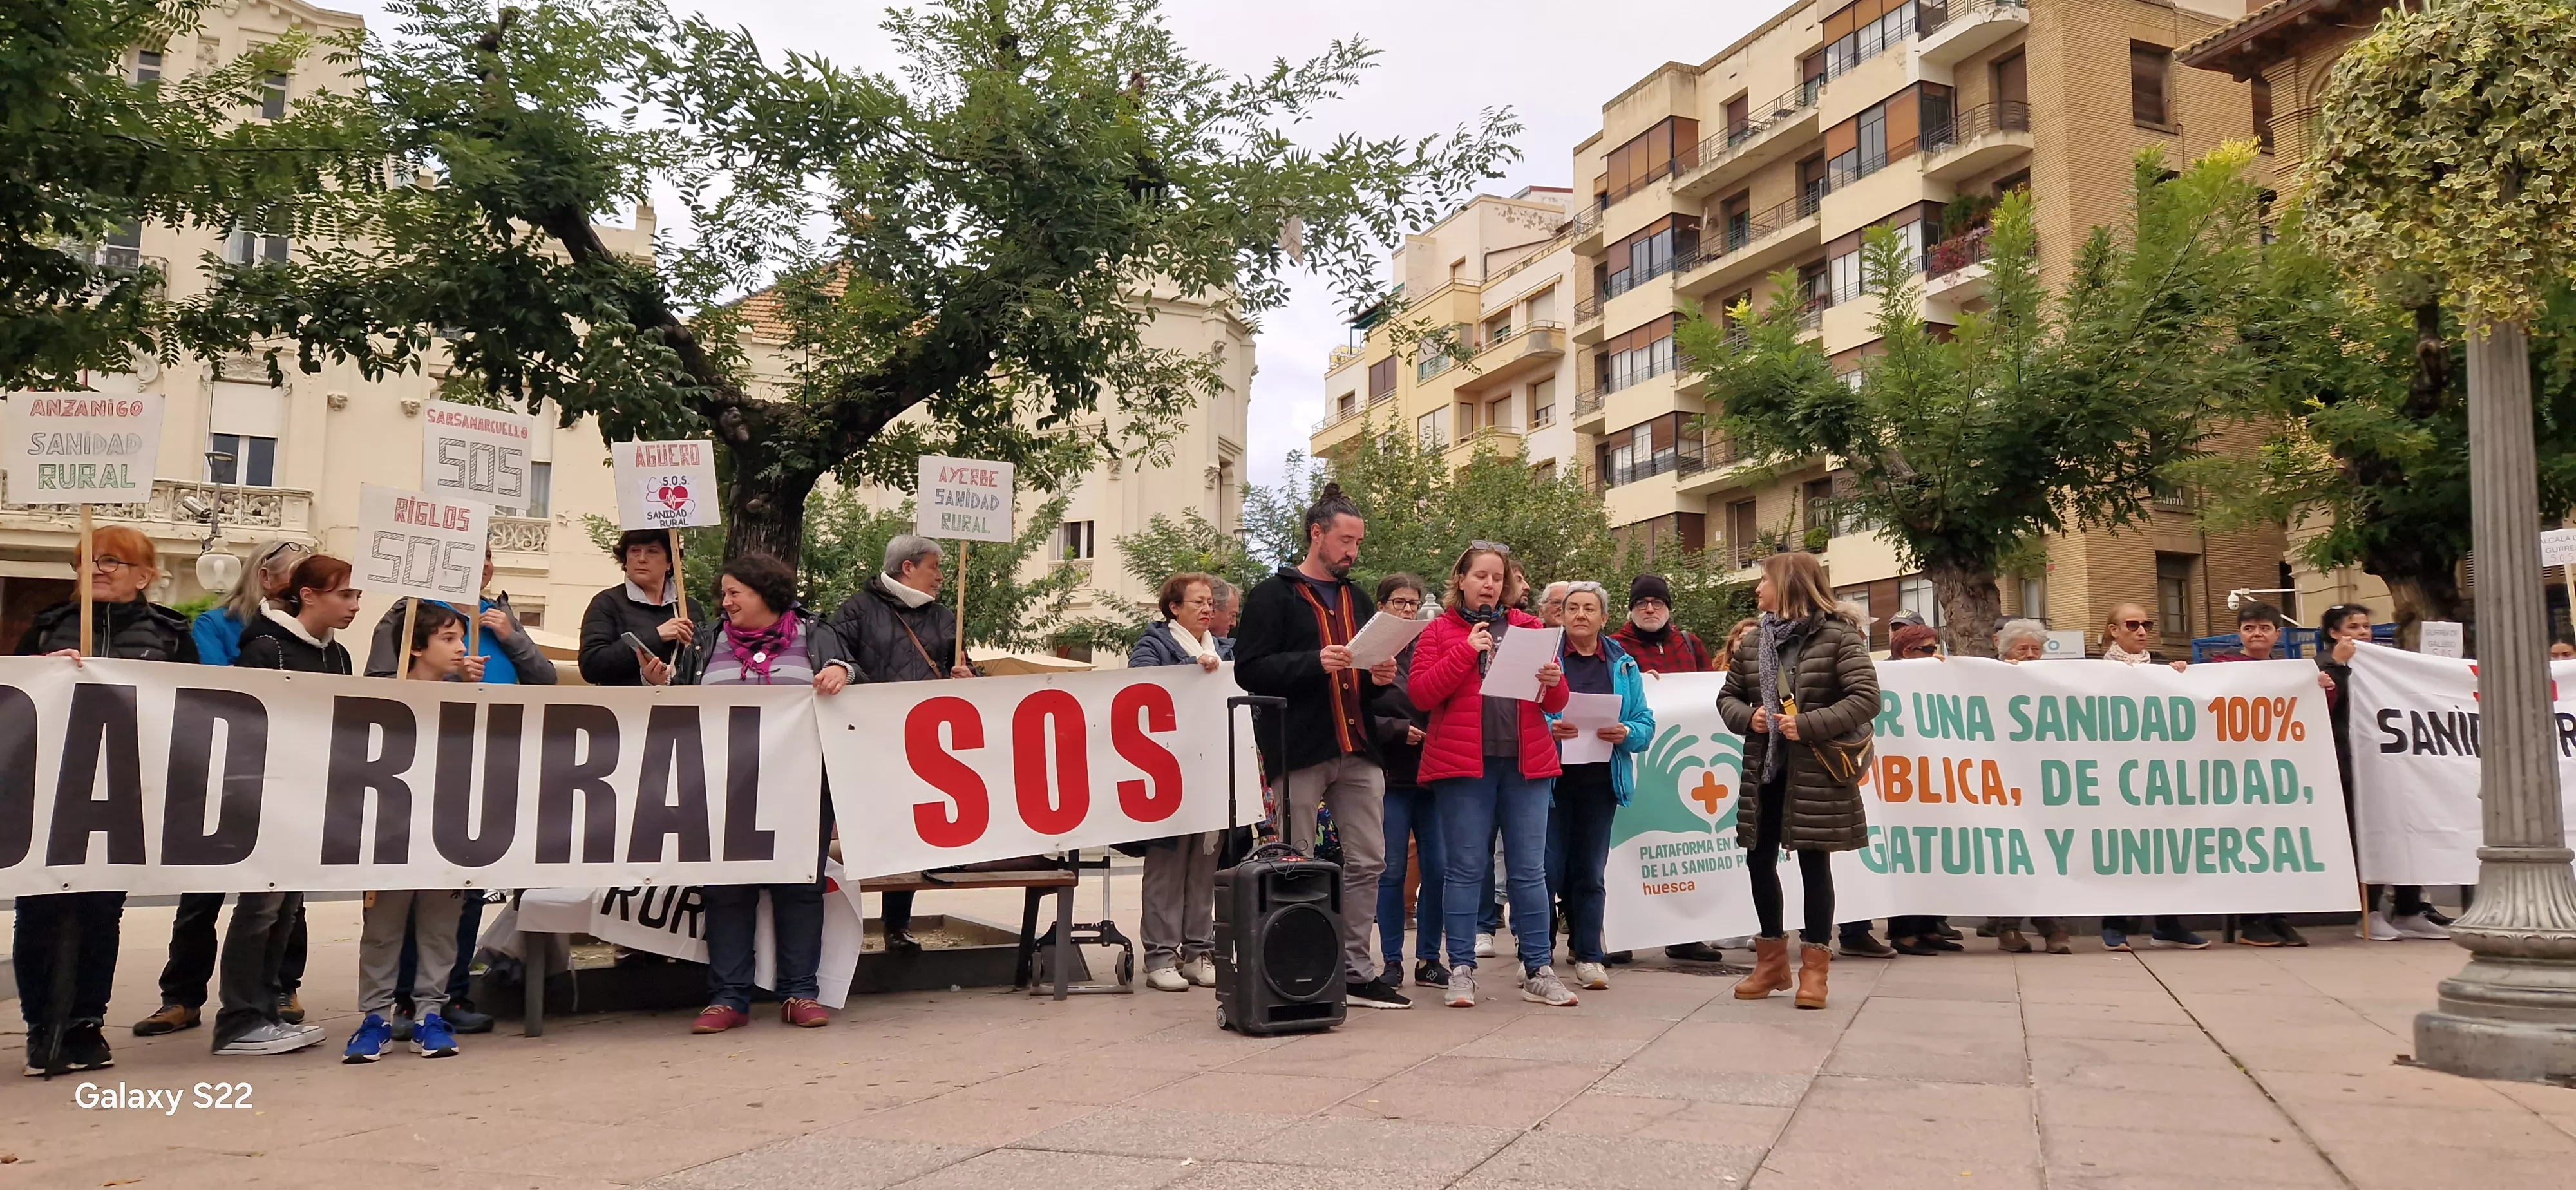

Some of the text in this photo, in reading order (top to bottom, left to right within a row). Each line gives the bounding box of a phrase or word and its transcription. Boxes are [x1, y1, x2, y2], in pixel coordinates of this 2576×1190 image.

[427, 408, 528, 439] SARSAMARCUELLO
[437, 437, 523, 497] SOS
[636, 444, 700, 467] AGÜERO
[38, 464, 136, 489] RURAL
[663, 475, 690, 486] S.O.S.
[939, 466, 998, 487] AYERBE
[647, 509, 687, 520] SANIDAD
[659, 517, 689, 527] RURAL
[941, 513, 990, 534] RURAL
[367, 530, 475, 593] SOS
[2545, 545, 2576, 554] GURRE
[1912, 692, 1996, 741] UNA
[2008, 695, 2196, 742] SANIDAD
[2208, 696, 2306, 742] 100%
[904, 683, 1183, 848] SOS
[321, 695, 776, 868] RURAL
[2041, 759, 2100, 806] DE
[2119, 759, 2313, 806] CALIDAD,
[1640, 838, 1714, 860] PLATAFORMA
[1716, 836, 1731, 852] EN
[2044, 829, 2075, 875] Y
[2092, 826, 2325, 875] UNIVERSAL
[1641, 864, 1658, 878] DE
[1662, 862, 1678, 877] LA
[1682, 856, 1733, 874] SANIDAD
[1643, 880, 1695, 895] huesca
